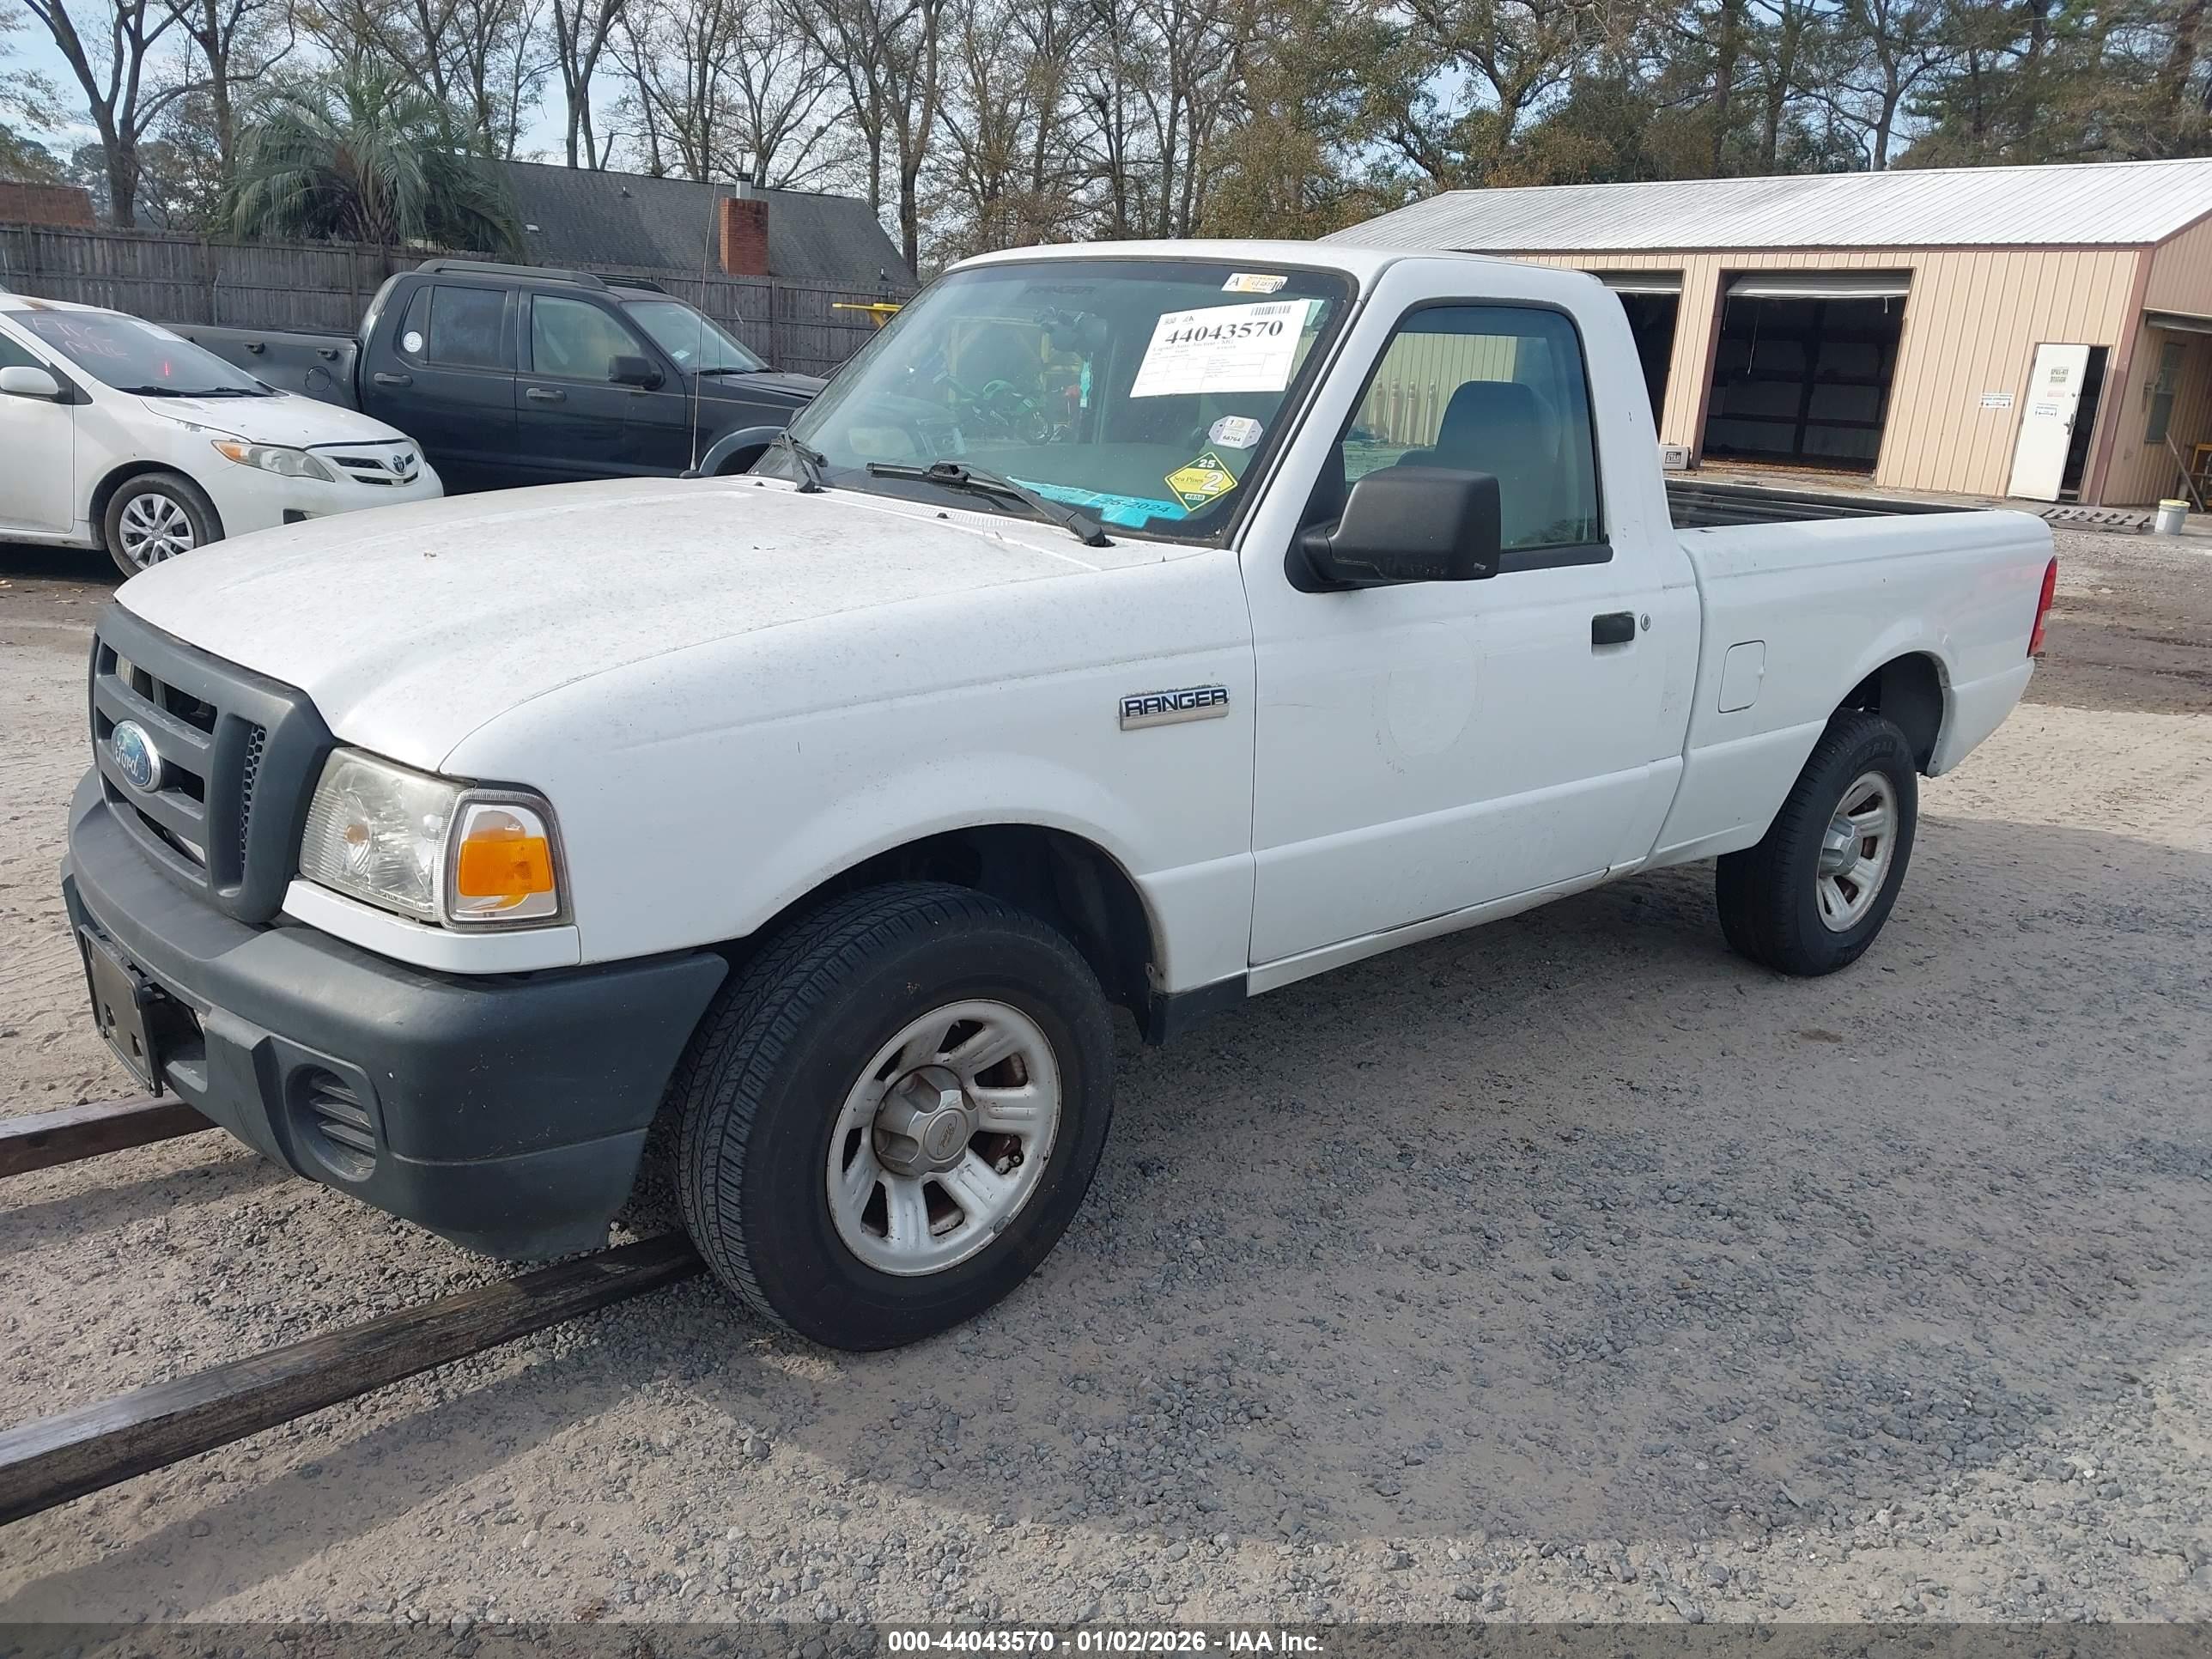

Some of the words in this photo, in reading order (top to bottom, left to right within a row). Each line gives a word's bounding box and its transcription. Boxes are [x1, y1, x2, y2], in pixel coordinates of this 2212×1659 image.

[1165, 319, 1284, 344] 44043570
[1198, 459, 1217, 468] 25
[1200, 471, 1224, 493] 2
[1124, 688, 1229, 717] RANGER
[114, 734, 139, 777] Ford
